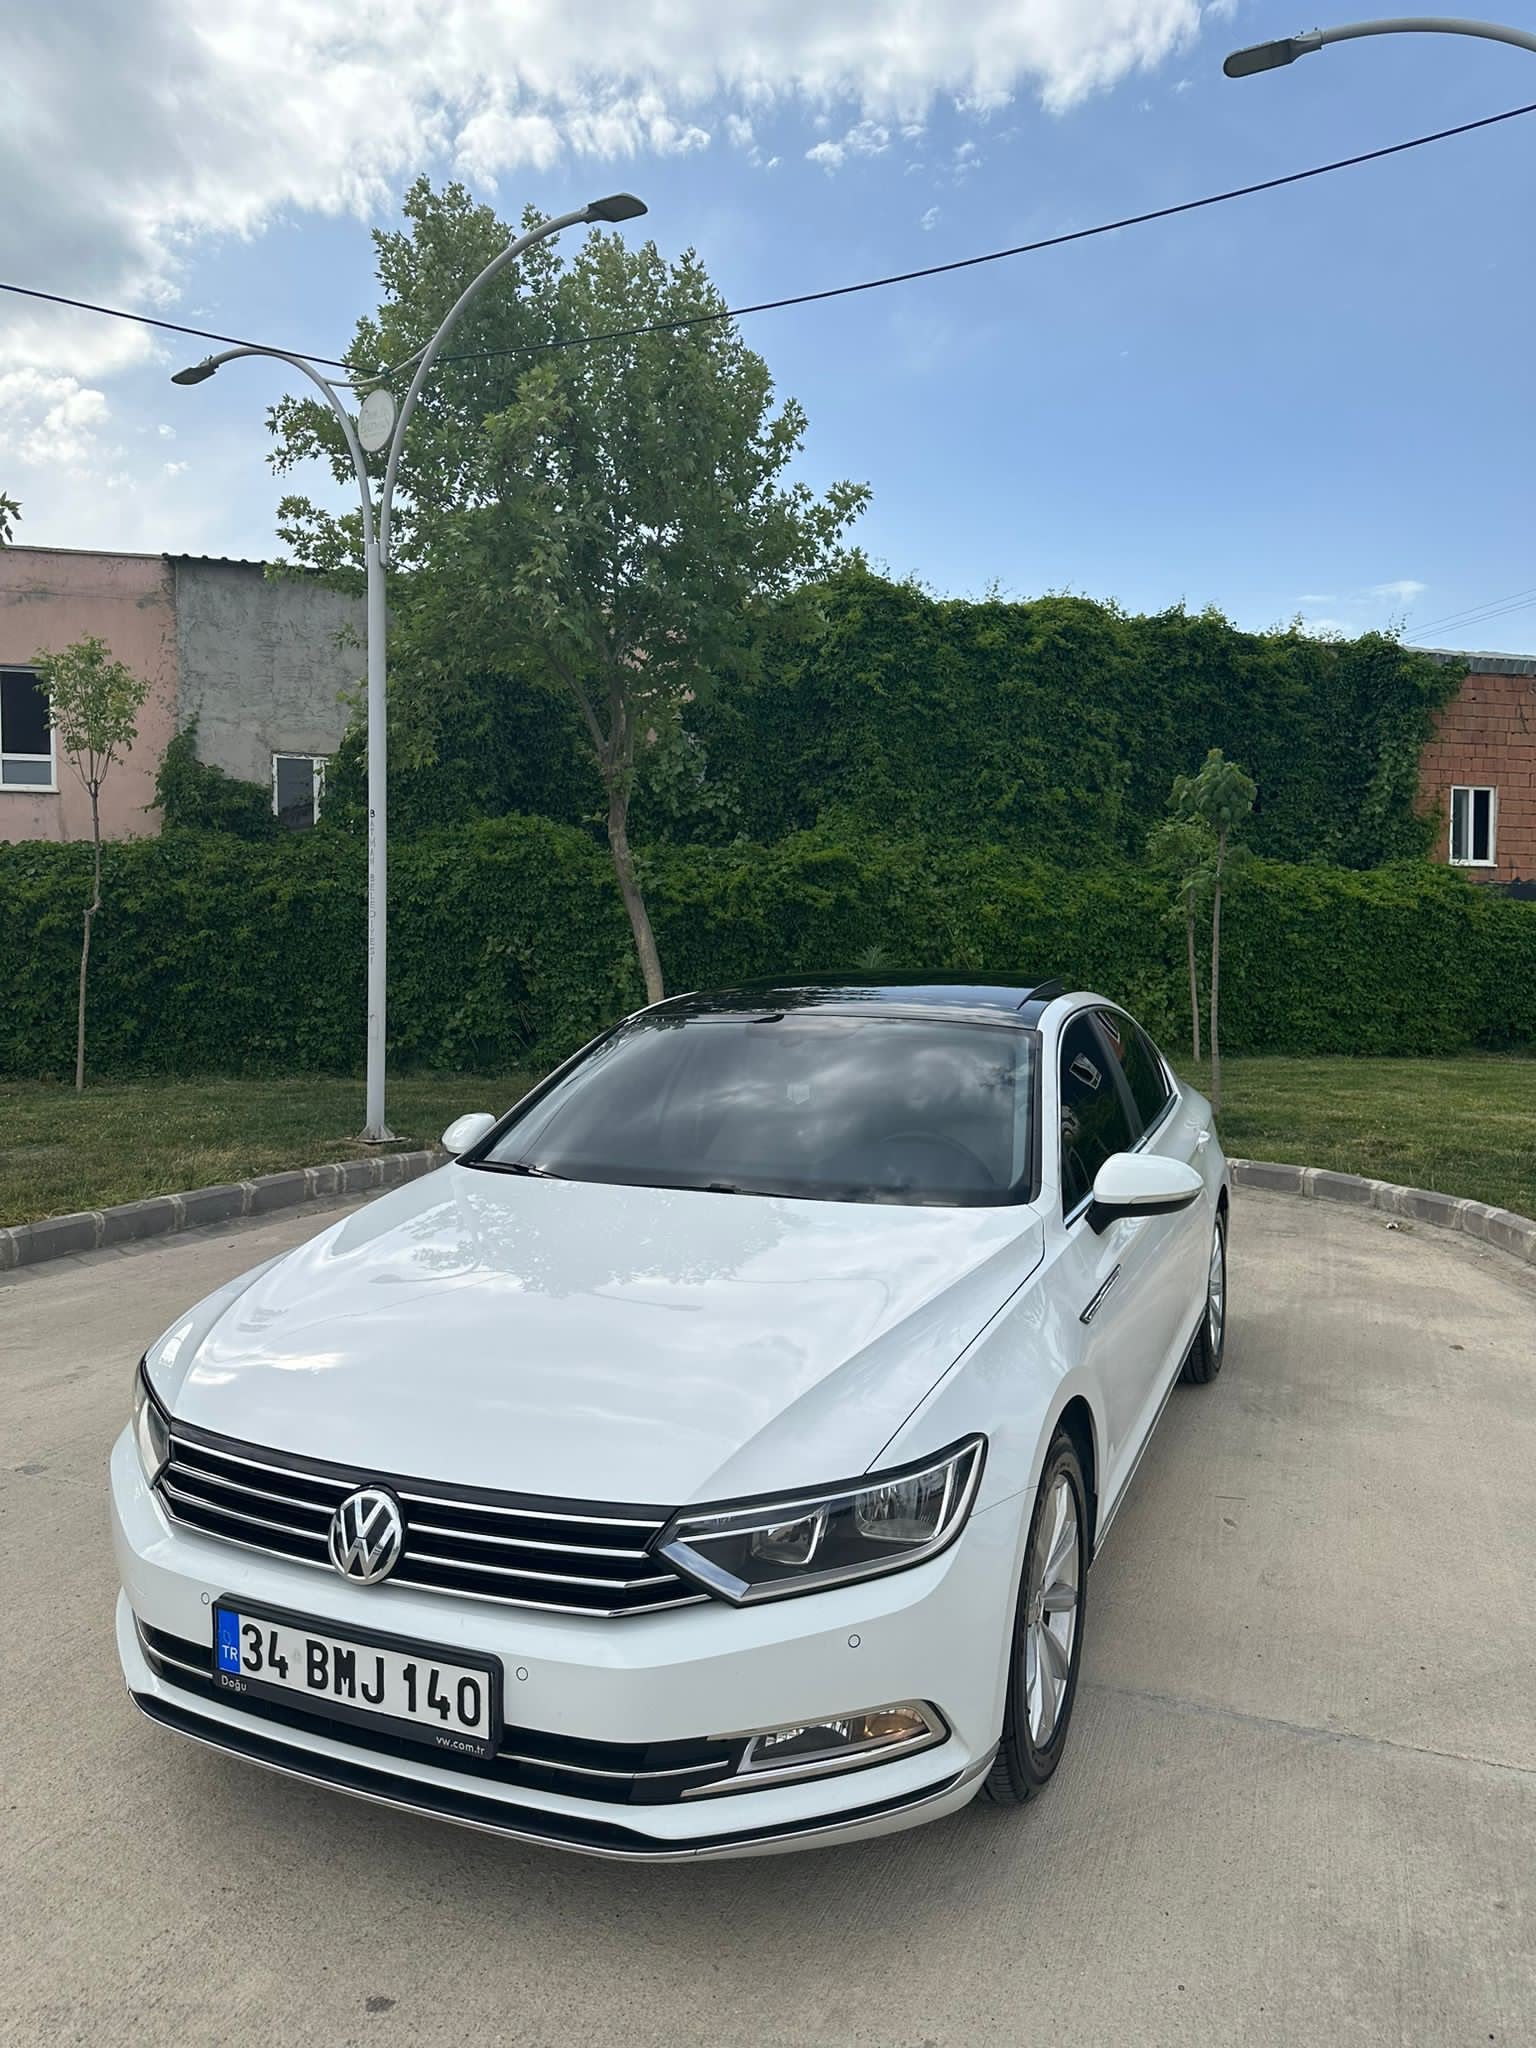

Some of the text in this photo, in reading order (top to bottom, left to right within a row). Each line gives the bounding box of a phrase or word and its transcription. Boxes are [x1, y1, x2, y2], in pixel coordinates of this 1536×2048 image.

[329, 1491, 402, 1585] VW
[221, 1644, 239, 1662] TR
[221, 1674, 247, 1692] Doğu
[241, 1623, 481, 1728] 34 BMJ 140
[435, 1735, 486, 1756] vw.com.tr
